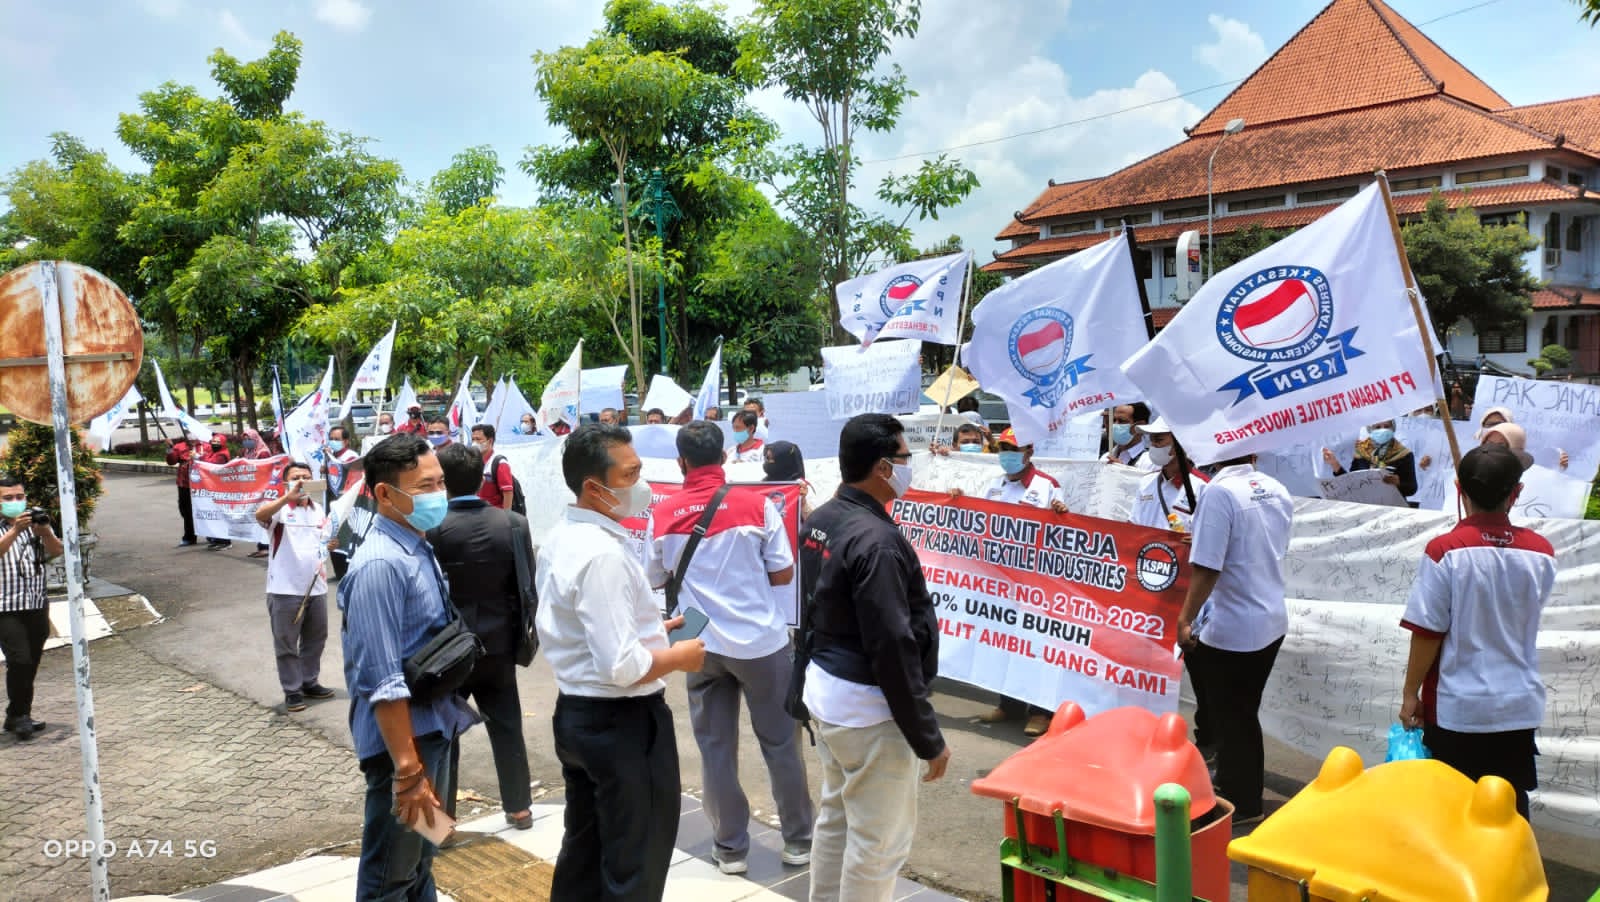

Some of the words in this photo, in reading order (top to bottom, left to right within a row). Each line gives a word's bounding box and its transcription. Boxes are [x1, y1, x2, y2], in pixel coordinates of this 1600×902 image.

[1493, 378, 1537, 408] PAK
[891, 498, 988, 535] PENGURUS
[990, 515, 1041, 543] UNIT
[1043, 525, 1119, 561] KERJA
[910, 526, 926, 548] PT
[923, 528, 980, 559] KABANA
[982, 538, 1037, 571] TEXTILE
[1038, 551, 1127, 592] INDUSTRIES
[1142, 558, 1171, 576] KSPN
[930, 591, 958, 612] 0%
[965, 598, 1018, 625] UANG
[1022, 611, 1093, 647] BURUH
[1015, 583, 1050, 610] NO.
[1056, 594, 1066, 614] 2
[1070, 594, 1104, 623] Th.
[1105, 607, 1165, 640] 2022
[978, 628, 1037, 659] AMBIL
[1042, 648, 1099, 677] UANG
[1103, 662, 1169, 697] KAMI
